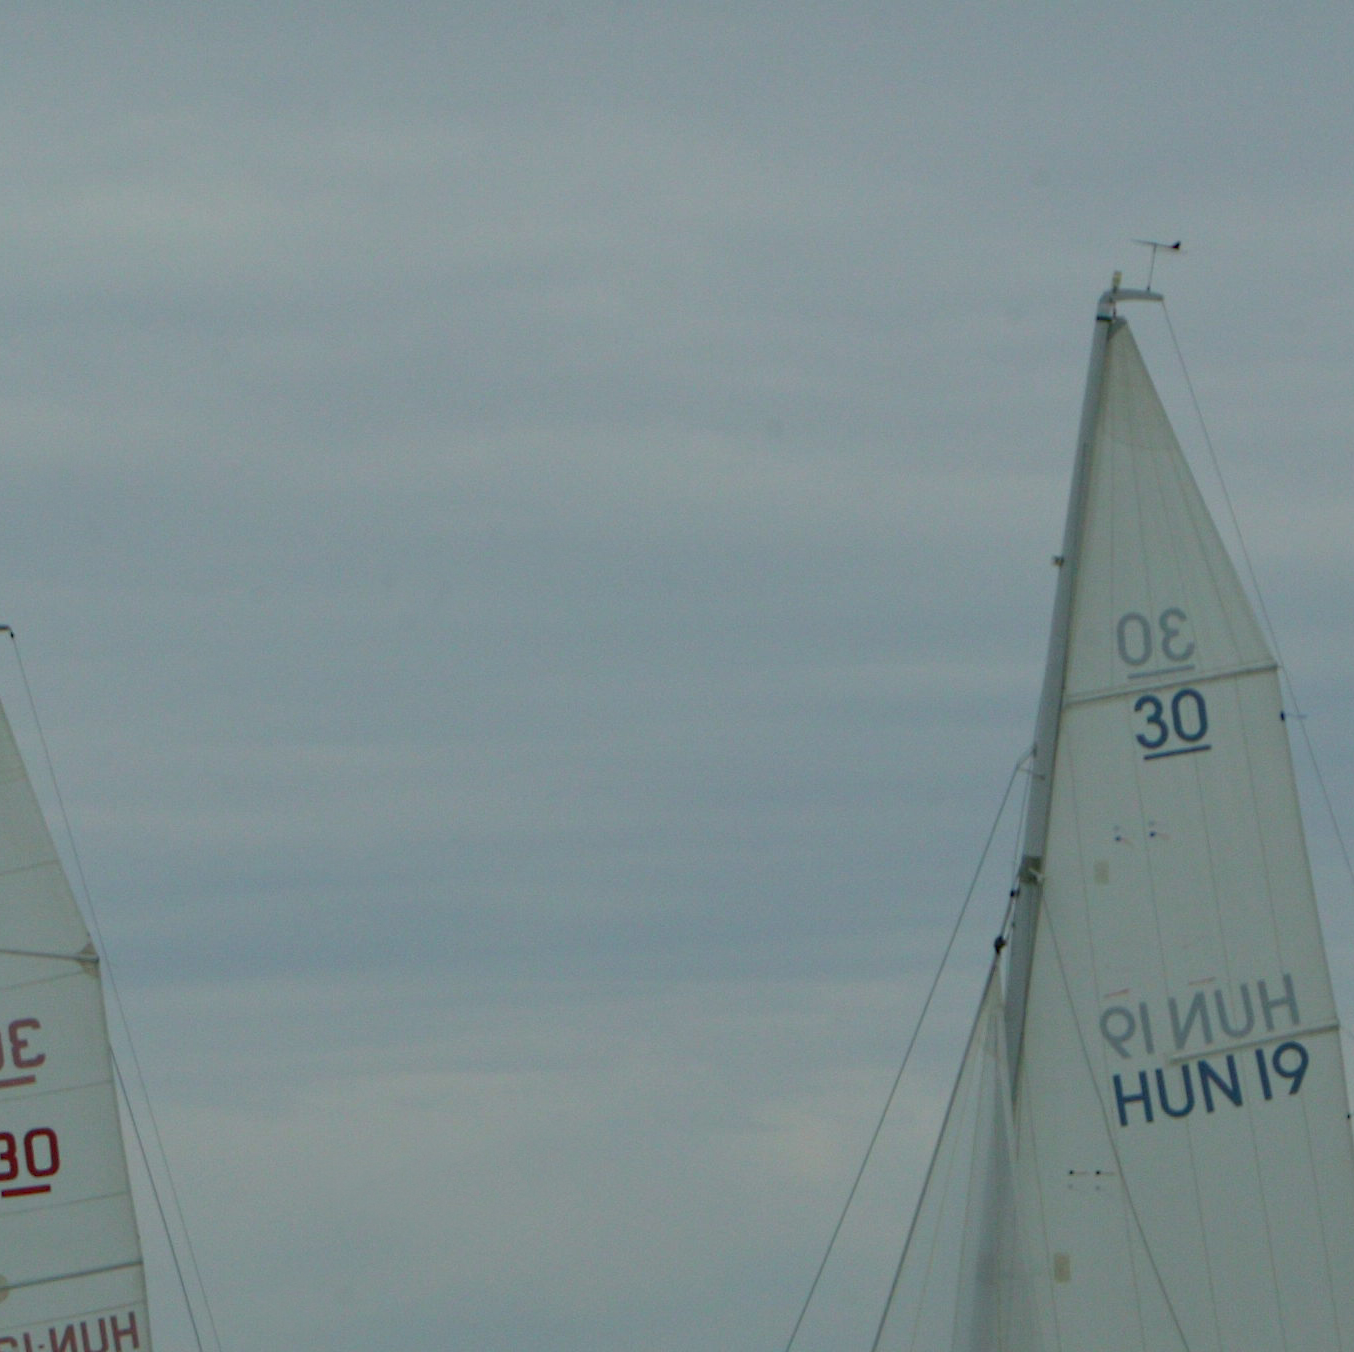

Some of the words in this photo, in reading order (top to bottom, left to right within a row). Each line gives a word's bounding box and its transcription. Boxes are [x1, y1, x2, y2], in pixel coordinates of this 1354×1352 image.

[1133, 688, 1209, 749] 30
[1112, 1053, 1243, 1127] HUN
[1254, 1040, 1309, 1101] 19
